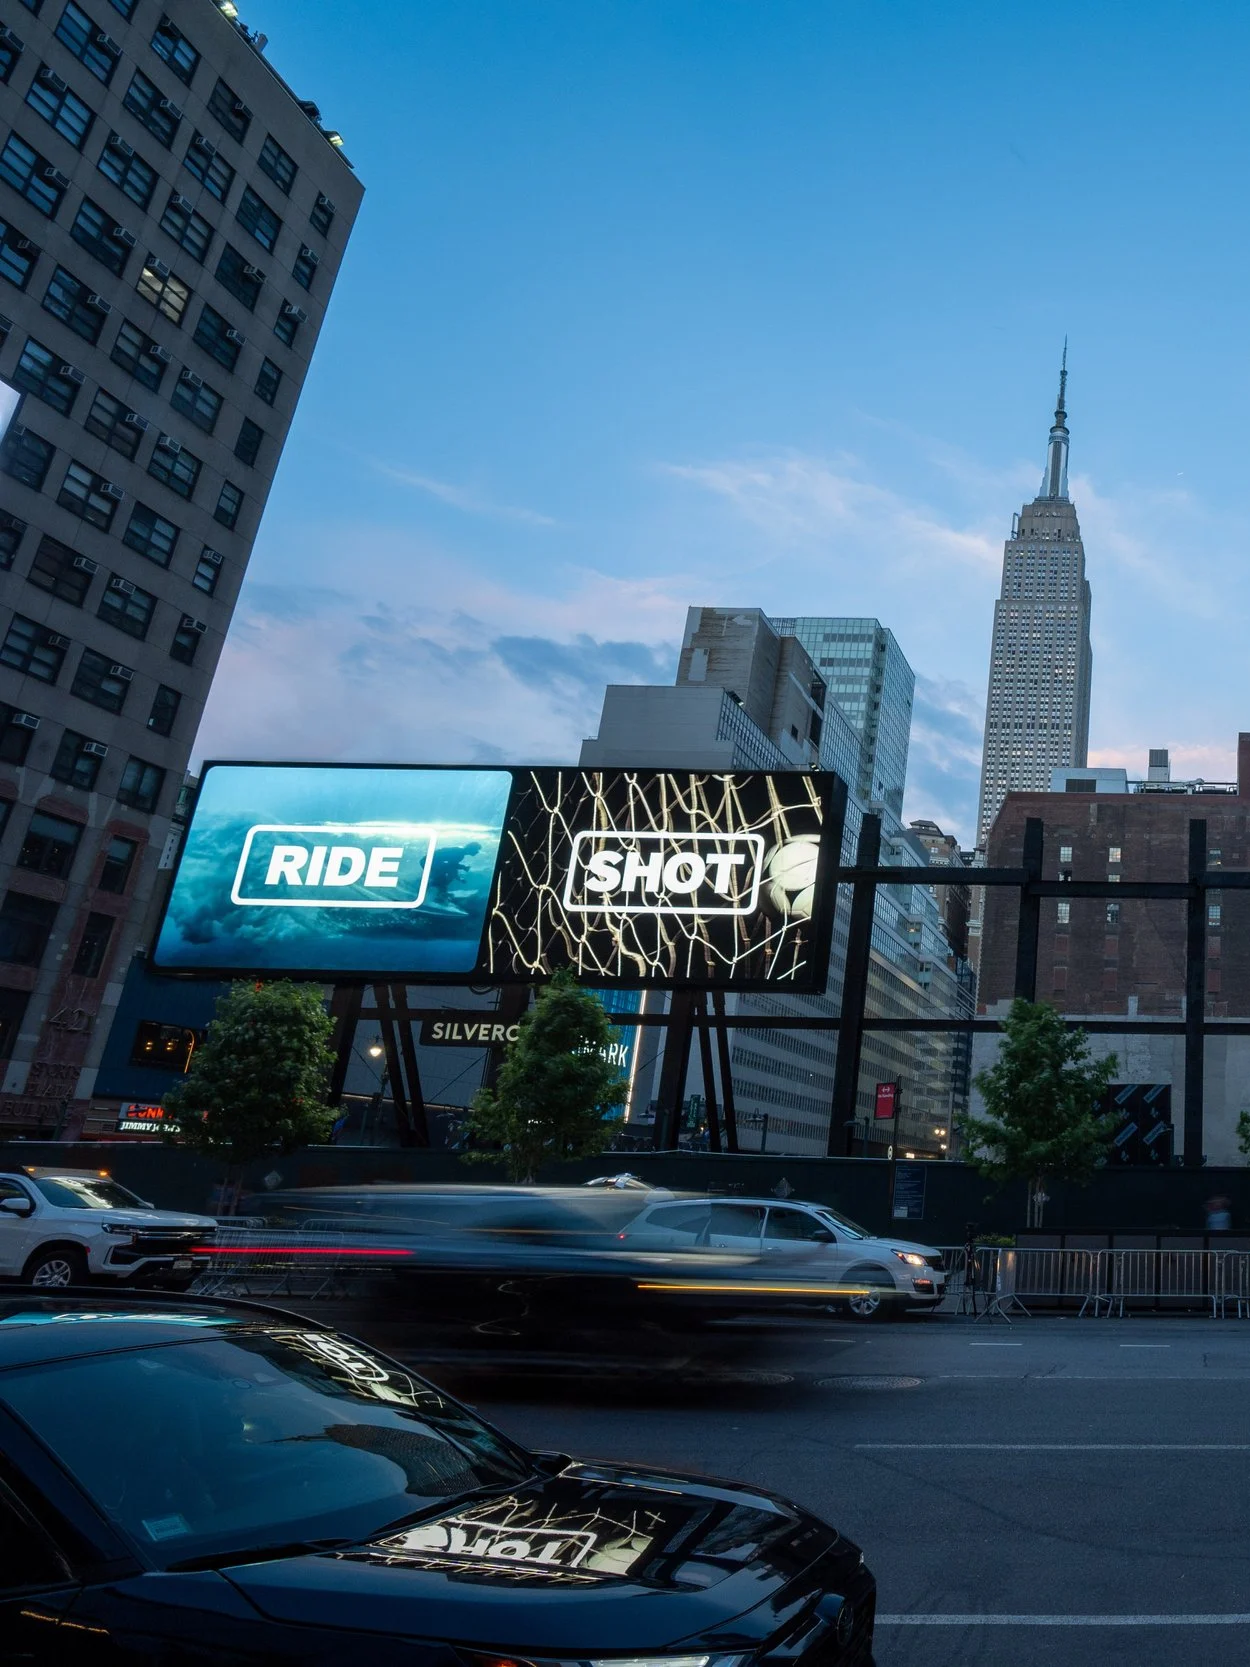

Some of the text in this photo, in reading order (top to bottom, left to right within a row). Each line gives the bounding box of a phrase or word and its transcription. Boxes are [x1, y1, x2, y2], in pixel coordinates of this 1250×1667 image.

[264, 846, 403, 888] RIDE
[584, 852, 745, 895] SHOT
[432, 1022, 520, 1041] SILVERC
